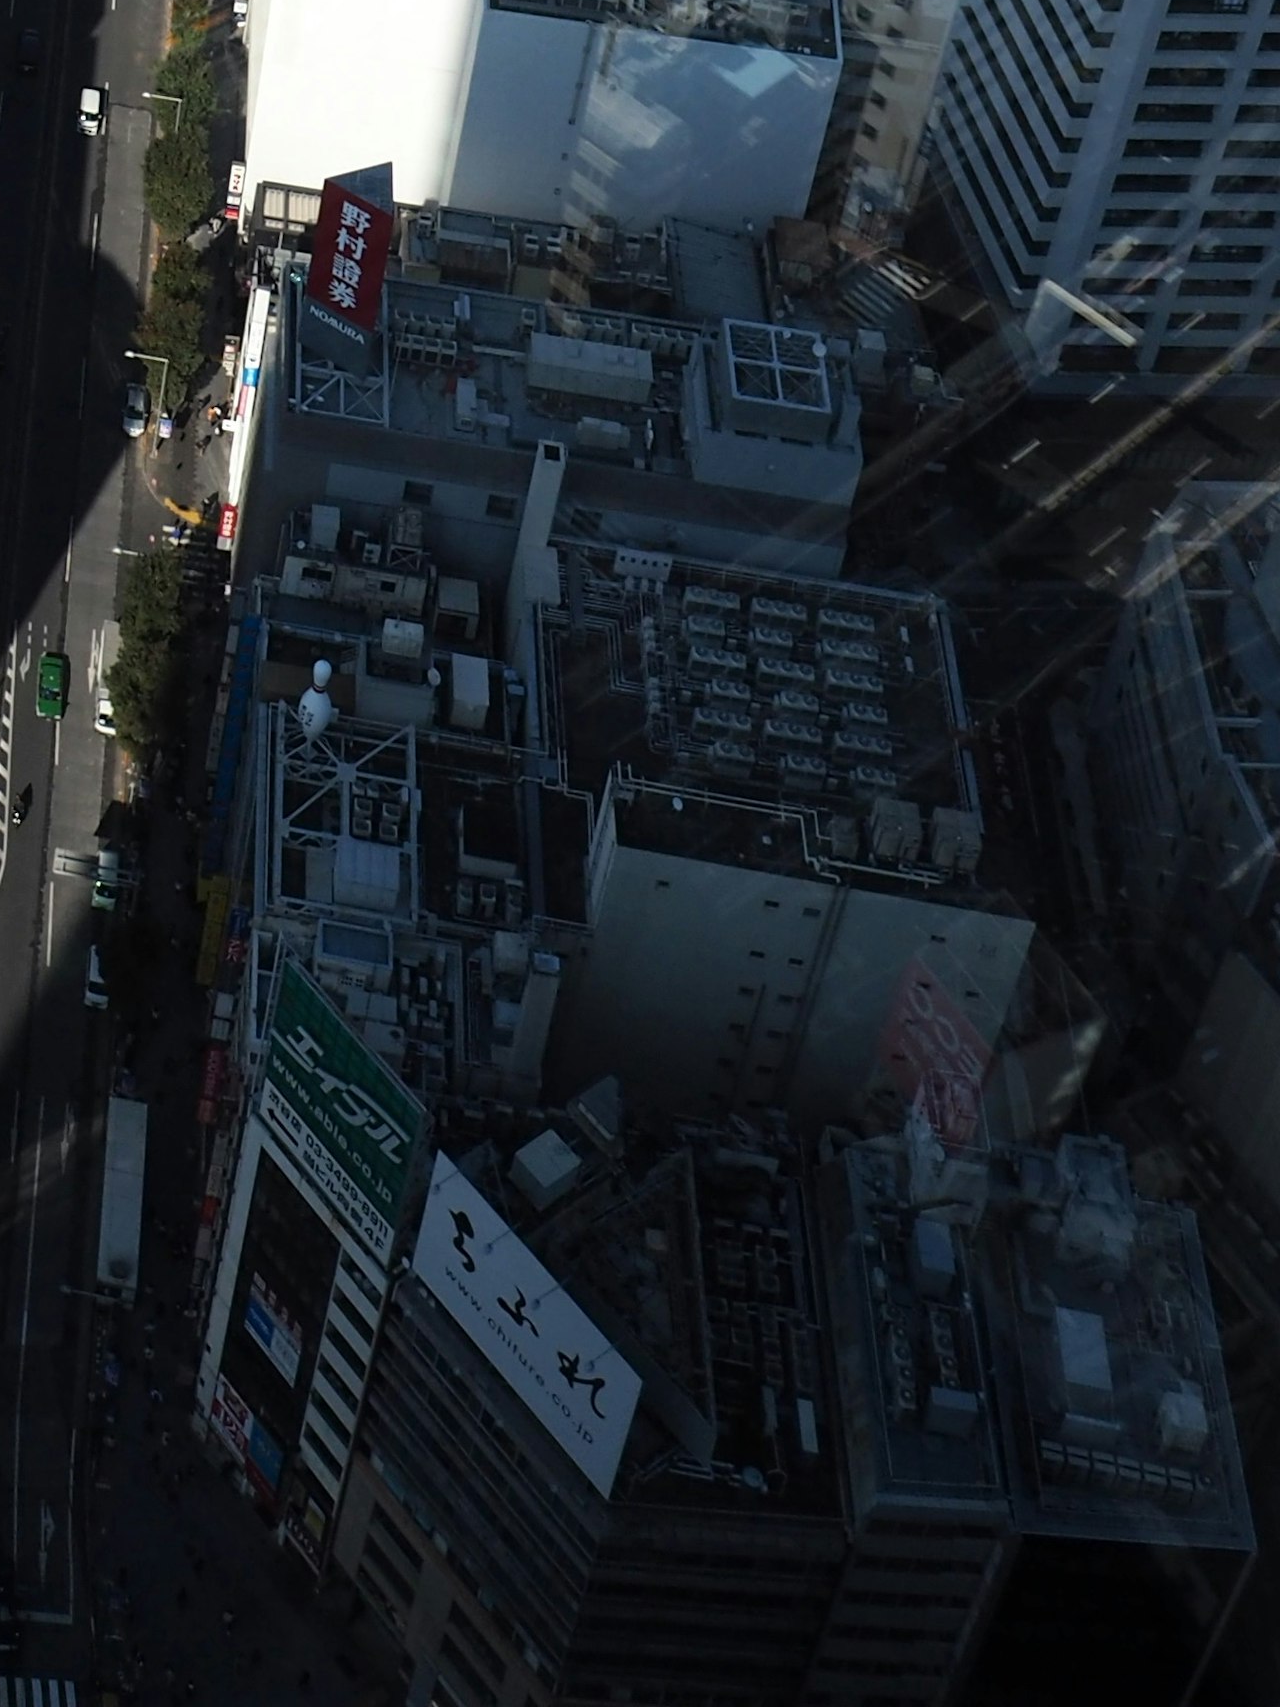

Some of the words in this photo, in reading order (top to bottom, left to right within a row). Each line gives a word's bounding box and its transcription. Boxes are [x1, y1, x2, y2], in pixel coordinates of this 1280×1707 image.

[309, 304, 367, 347] NOMURA
[329, 200, 373, 311] 野村證券
[269, 1024, 412, 1166] エイブル
[272, 1053, 394, 1205] www.able.co.jp
[444, 1265, 595, 1446] www.chifure.co.jp
